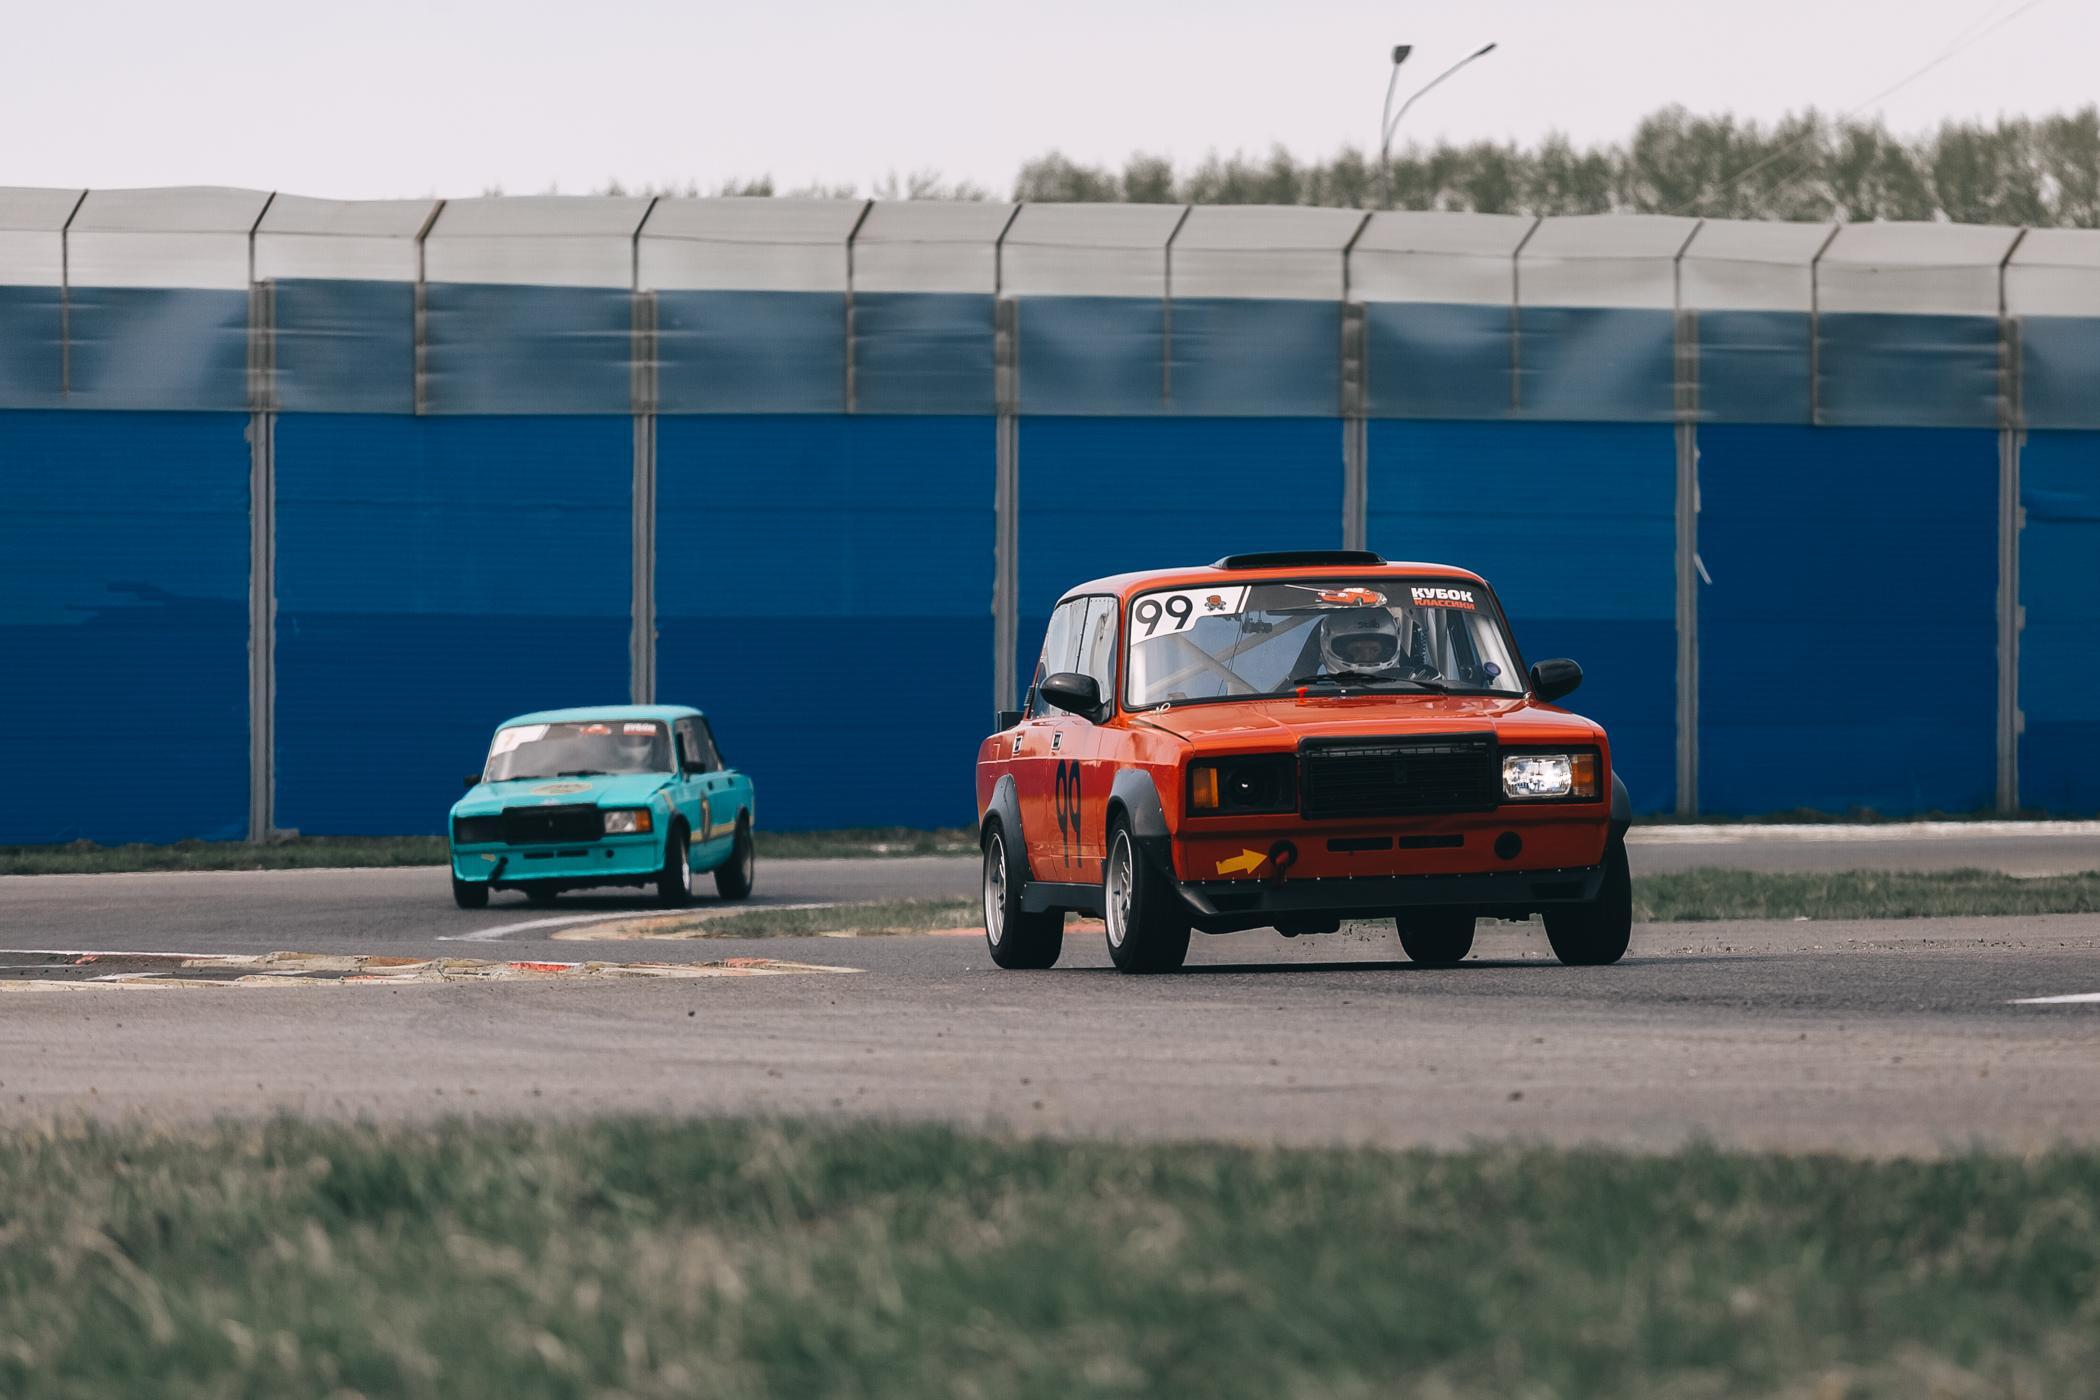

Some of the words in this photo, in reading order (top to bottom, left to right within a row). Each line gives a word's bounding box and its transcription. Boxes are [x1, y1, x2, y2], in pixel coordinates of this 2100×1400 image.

[1135, 594, 1194, 637] 99
[1411, 587, 1474, 603] КУБОК
[1055, 758, 1083, 869] 99
